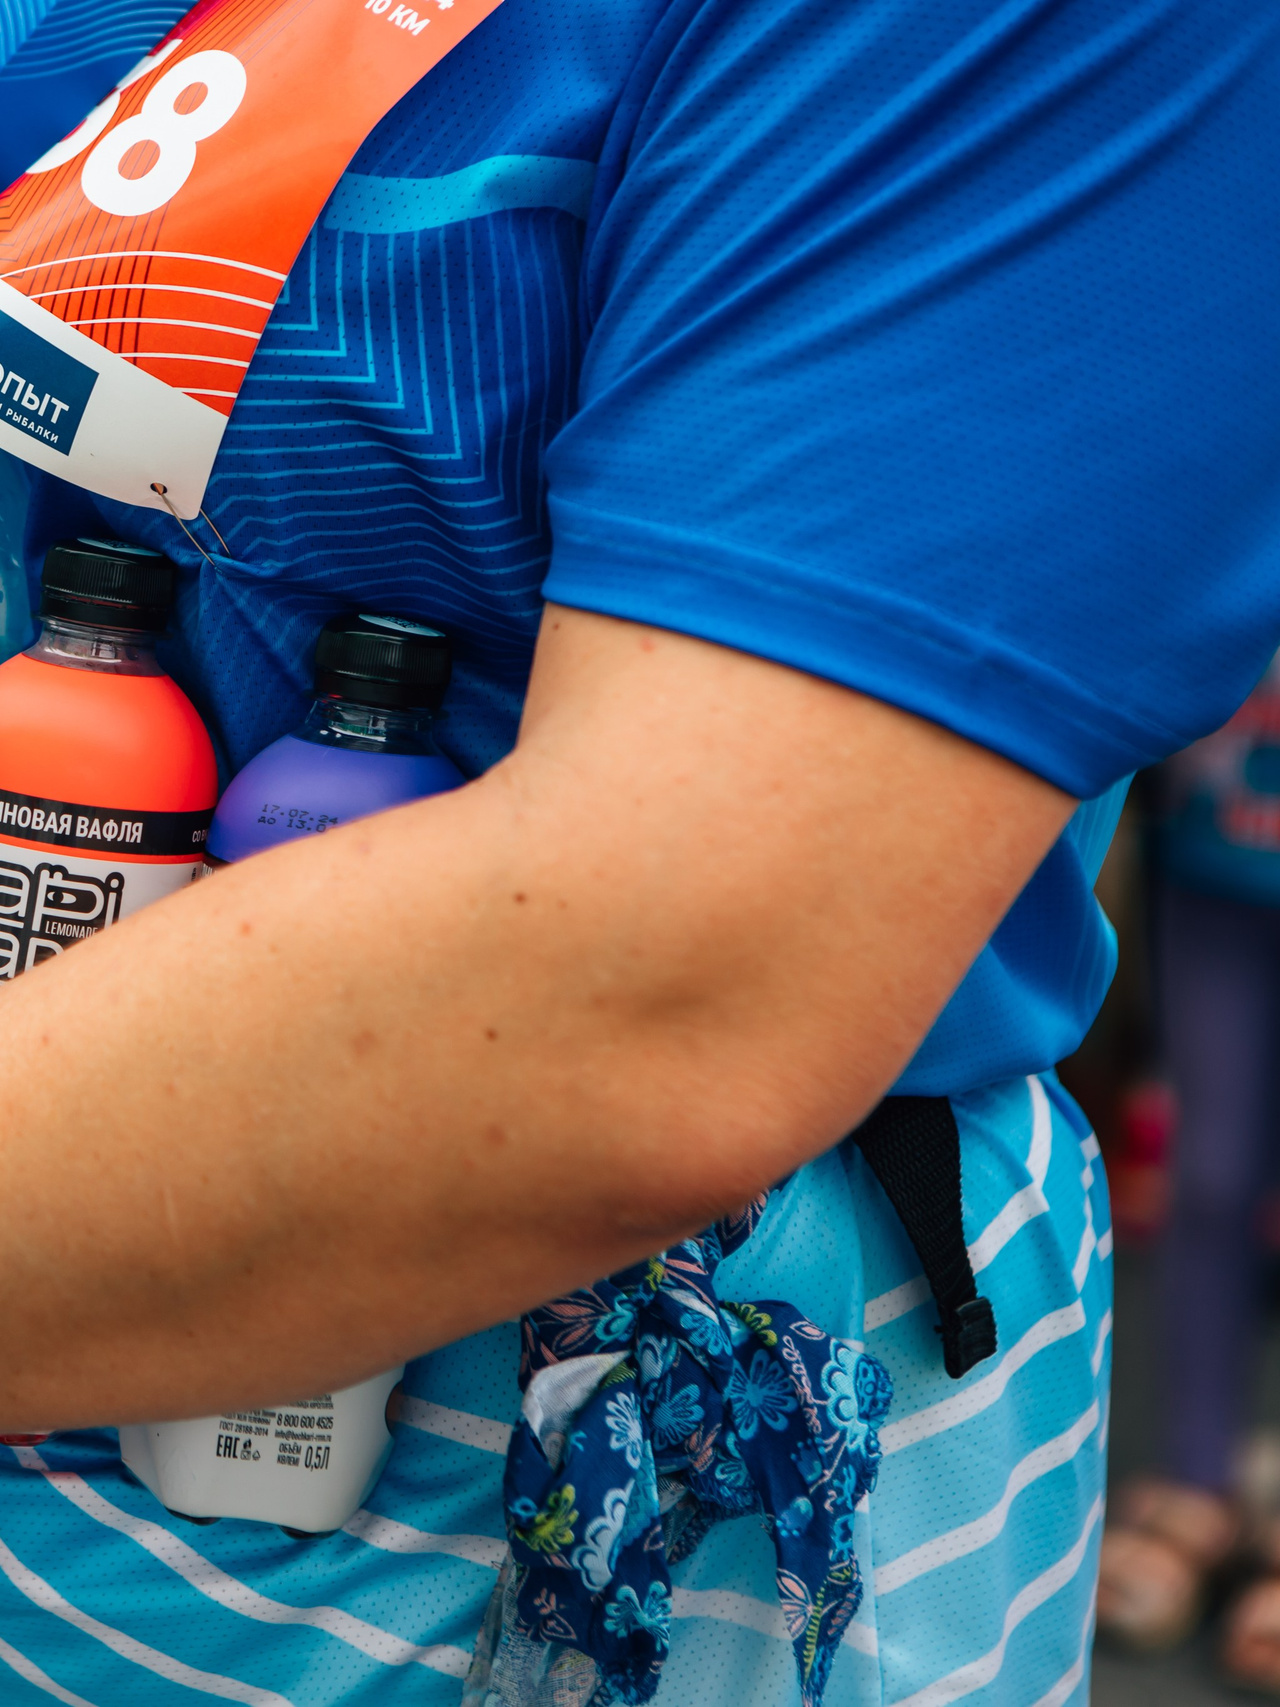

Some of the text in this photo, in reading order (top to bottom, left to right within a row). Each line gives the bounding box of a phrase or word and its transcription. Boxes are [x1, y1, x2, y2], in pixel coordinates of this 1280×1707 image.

[6, 407, 60, 444] РЫБАЛКИ
[261, 803, 339, 825] 17.07.24
[75, 817, 144, 843] ВАФЛЯ
[219, 1420, 234, 1431] ГОСТ
[276, 1413, 283, 1427] 8
[283, 1414, 299, 1429] 800
[300, 1415, 315, 1430] 600
[316, 1416, 334, 1430] 4525
[304, 1446, 331, 1472] 0,5Л
